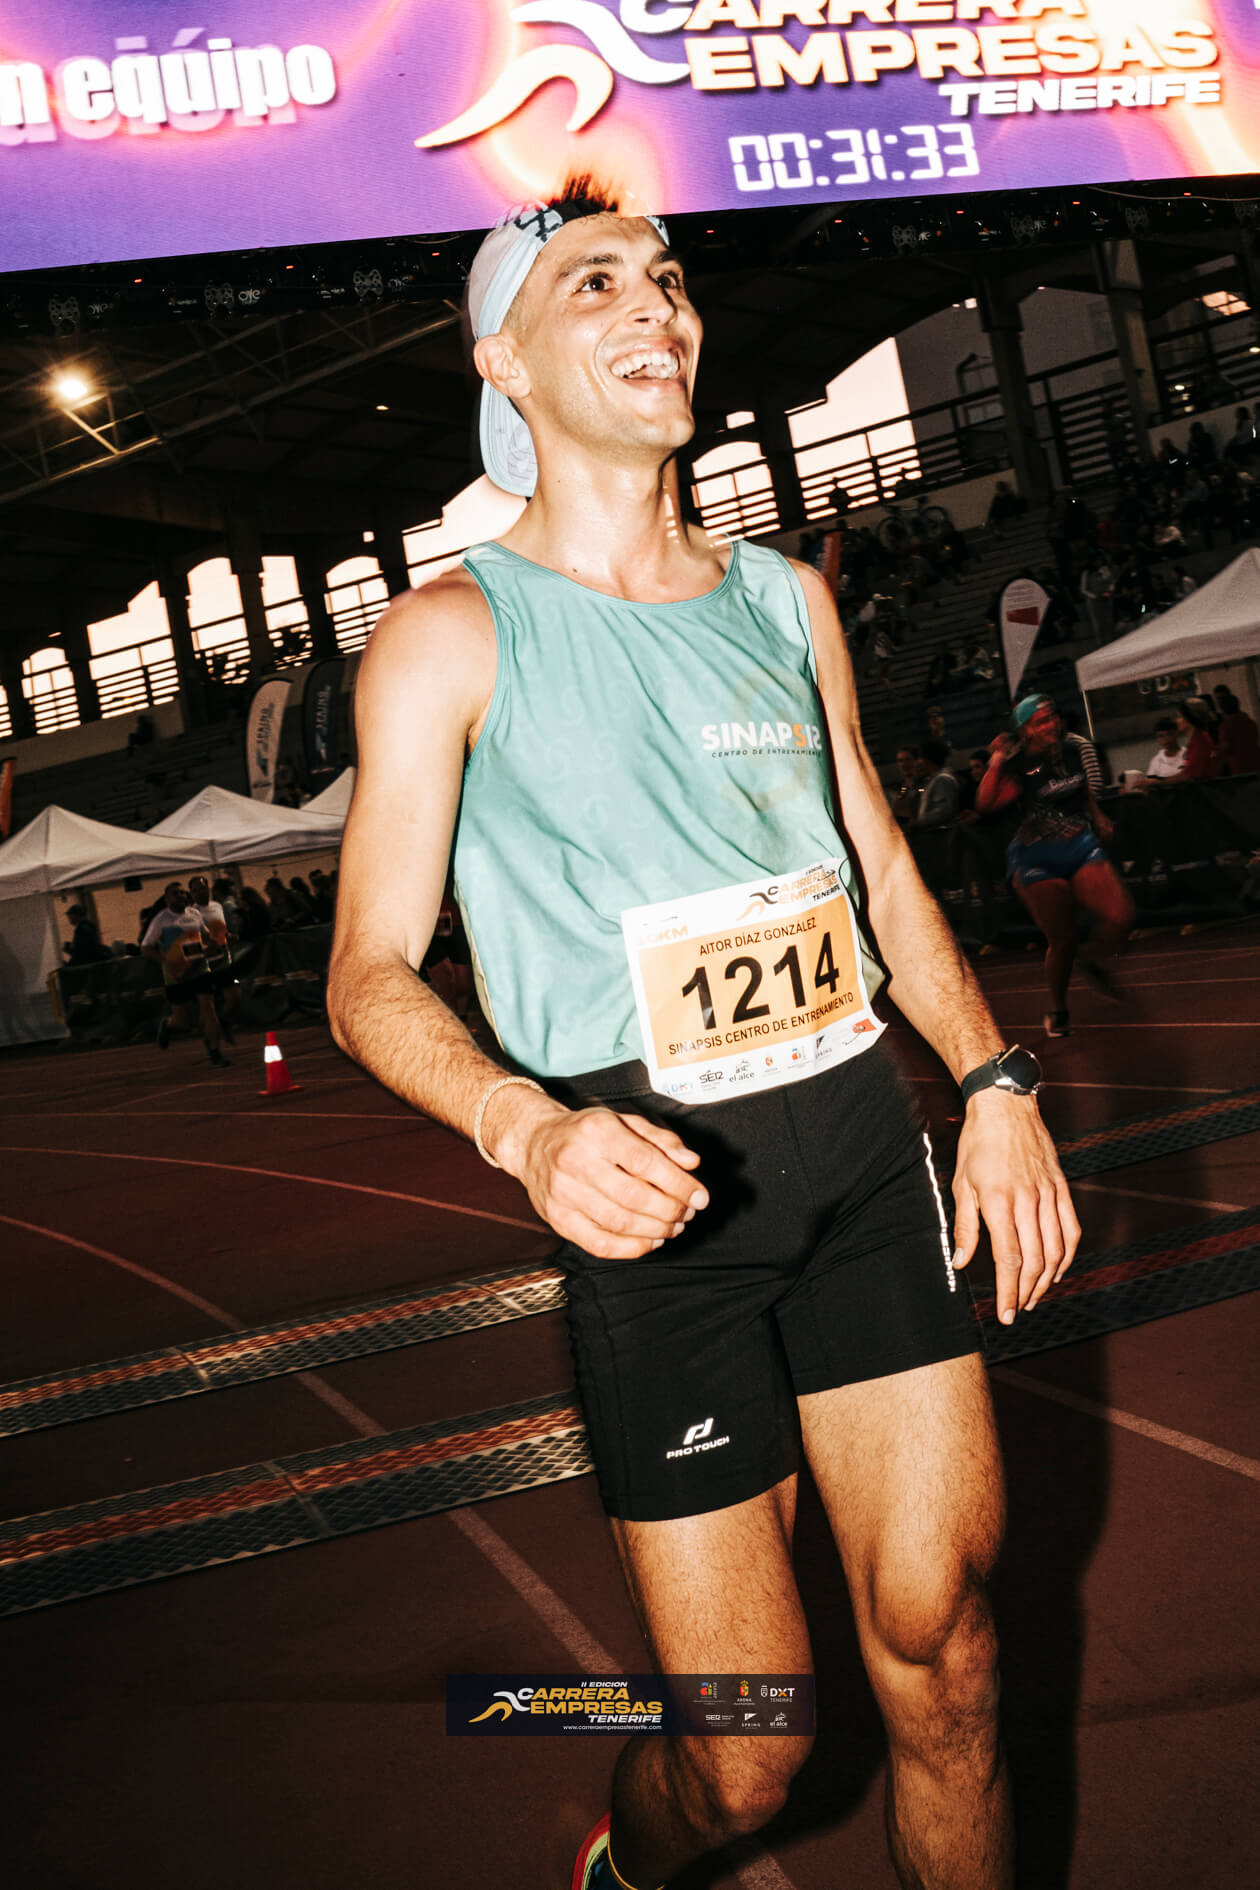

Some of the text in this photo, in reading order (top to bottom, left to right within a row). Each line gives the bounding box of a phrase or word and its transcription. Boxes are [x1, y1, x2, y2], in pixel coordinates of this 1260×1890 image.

[684, 21, 1219, 91] EMPRESAS
[938, 72, 1221, 116] TENERIFE
[727, 122, 982, 192] 00:31:33
[699, 938, 733, 957] AITOR
[735, 930, 762, 948] DÍAZ
[682, 931, 840, 1031] 1214
[668, 991, 854, 1055] SINAPSIS CENTRO DE ENTRENAMIENTO
[666, 1435, 730, 1459] PRO TOUCH
